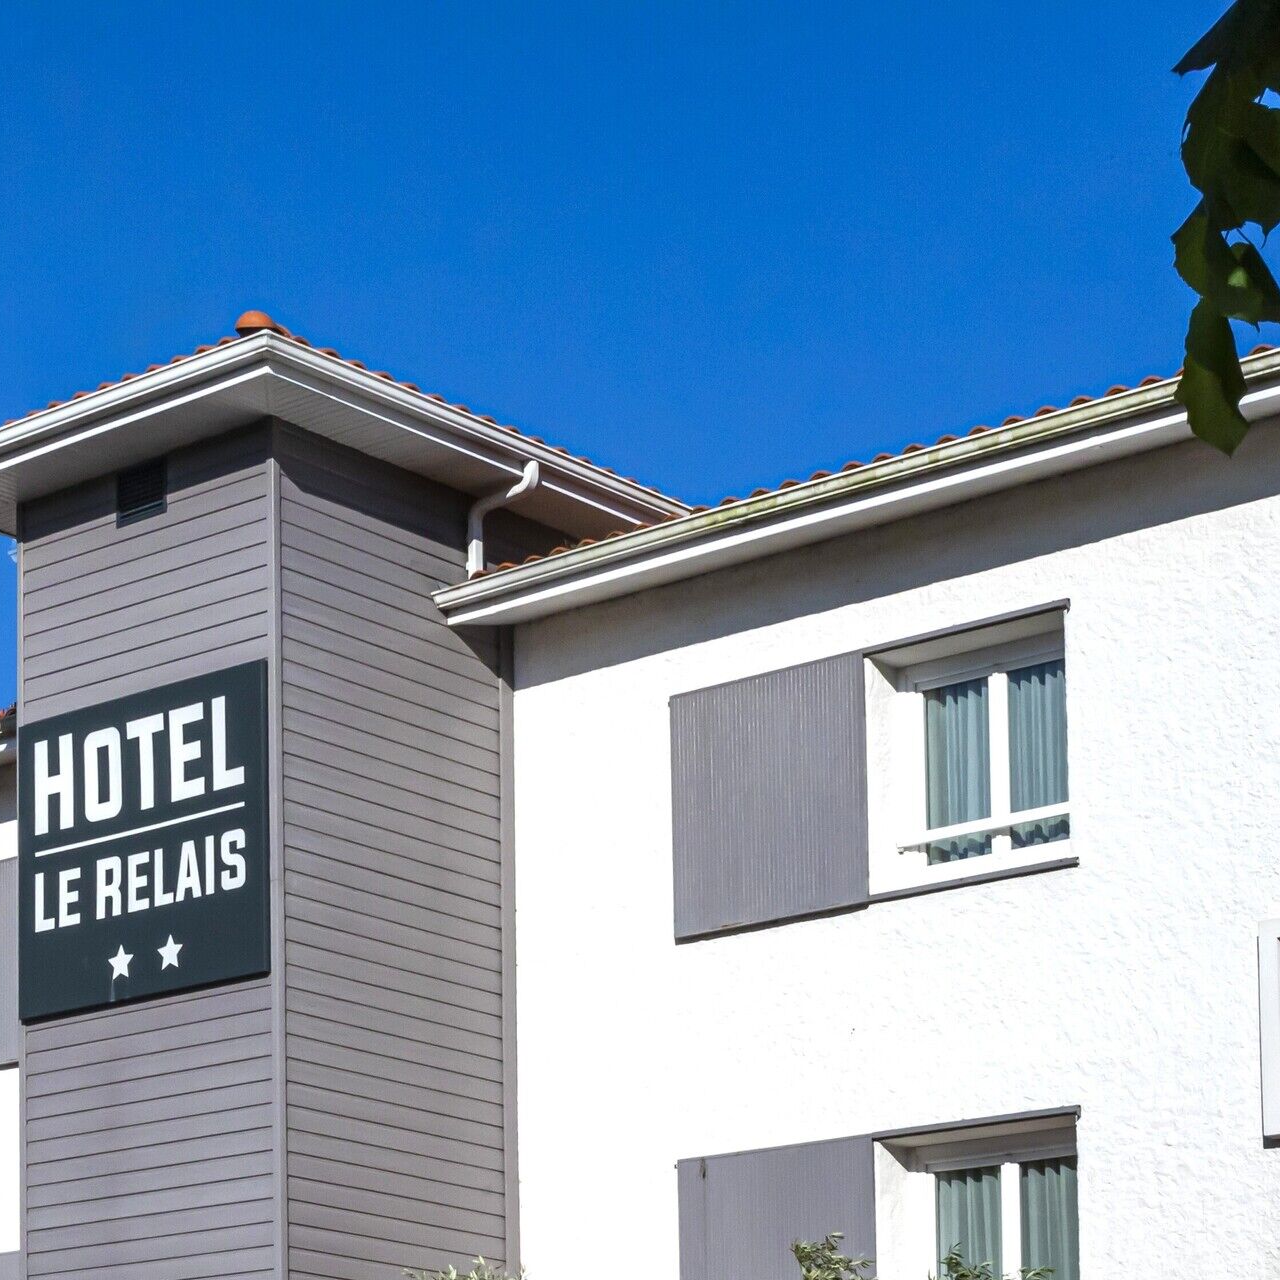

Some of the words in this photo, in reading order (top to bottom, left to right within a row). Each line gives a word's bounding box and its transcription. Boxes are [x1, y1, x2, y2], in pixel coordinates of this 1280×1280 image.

[33, 695, 246, 837] HOTEL
[34, 866, 82, 934] LE
[95, 827, 247, 921] RELAIS
